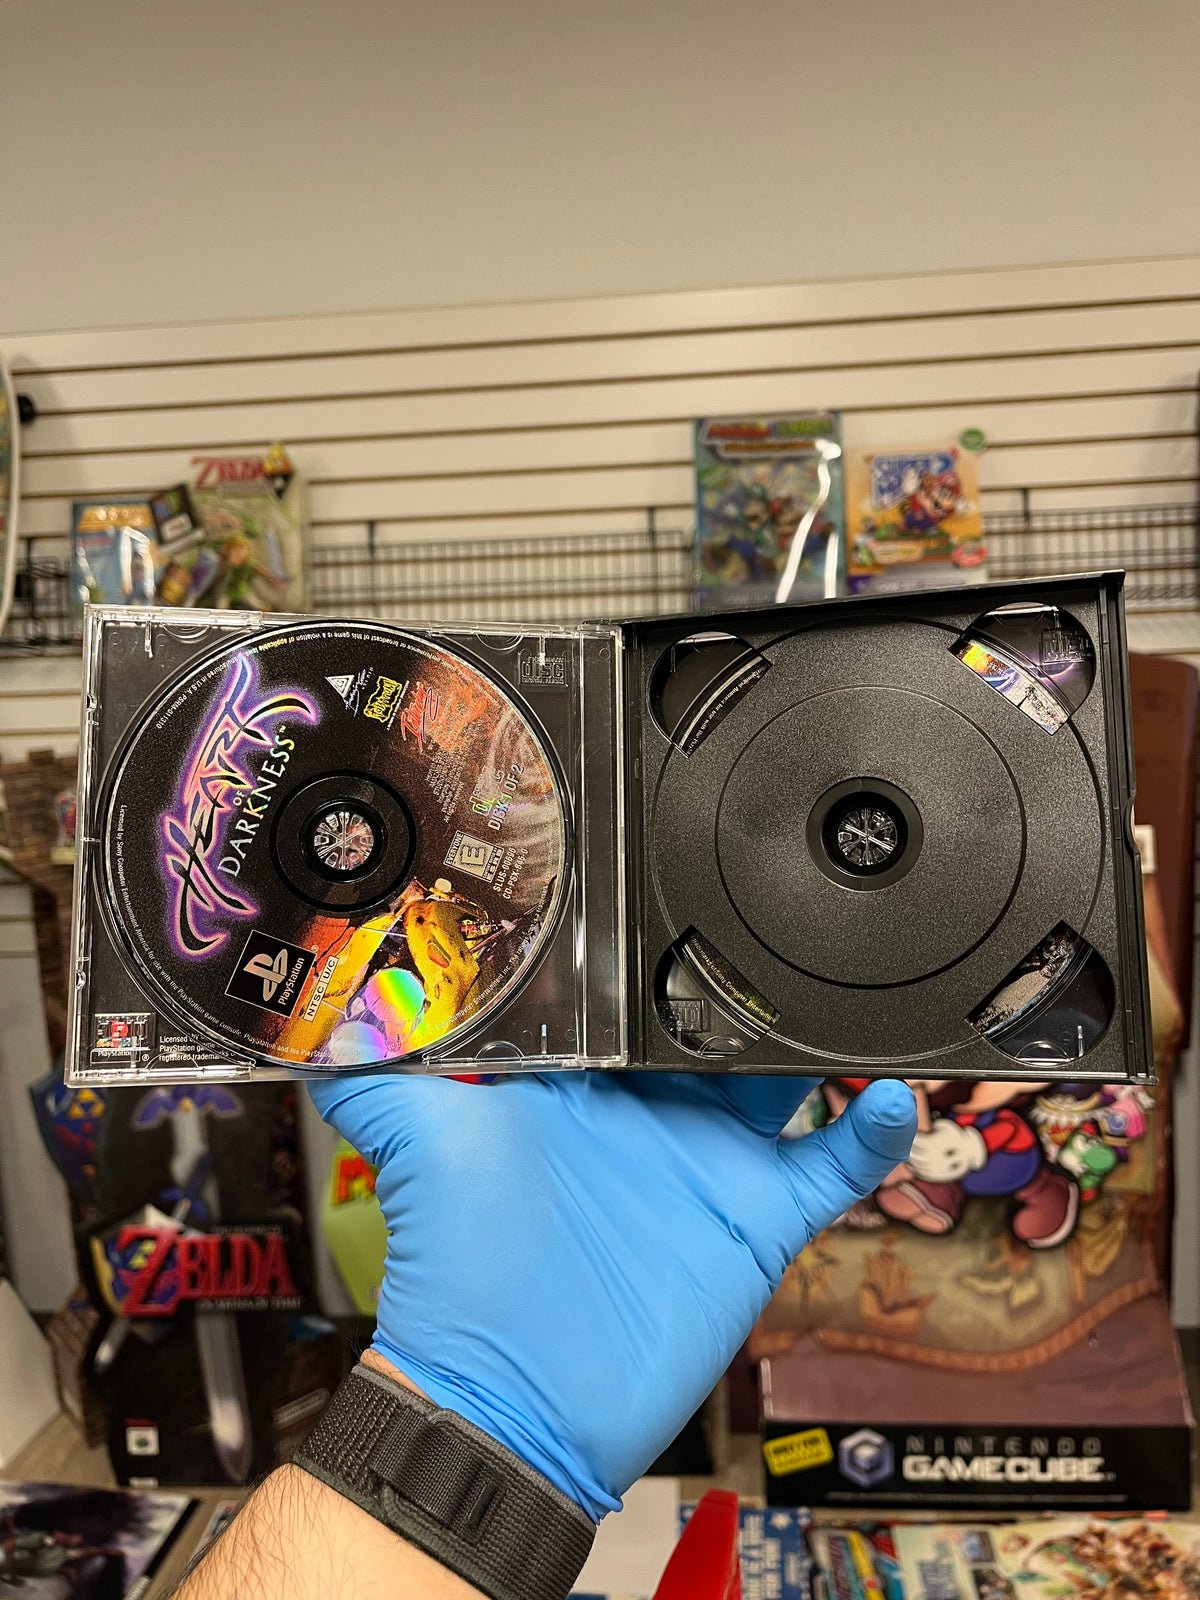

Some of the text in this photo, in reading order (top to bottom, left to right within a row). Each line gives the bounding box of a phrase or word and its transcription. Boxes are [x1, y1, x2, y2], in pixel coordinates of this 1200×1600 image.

[295, 632, 320, 641] violation
[233, 789, 246, 806] OF
[488, 802, 510, 831] DISK
[503, 775, 519, 791] OF
[511, 763, 525, 774] 2
[116, 803, 127, 831] Licensed
[446, 832, 464, 865] EVERYONE
[460, 844, 487, 867] E
[278, 957, 305, 1005] PlayStation
[307, 985, 325, 1017] NTSC
[160, 1035, 188, 1043] Licensed
[160, 1045, 196, 1053] PlayStation
[159, 1054, 192, 1063] registered
[116, 1223, 298, 1317] ZELDA
[905, 1435, 1102, 1455] NINTENDO
[902, 1455, 1106, 1482] GAMECUBE
